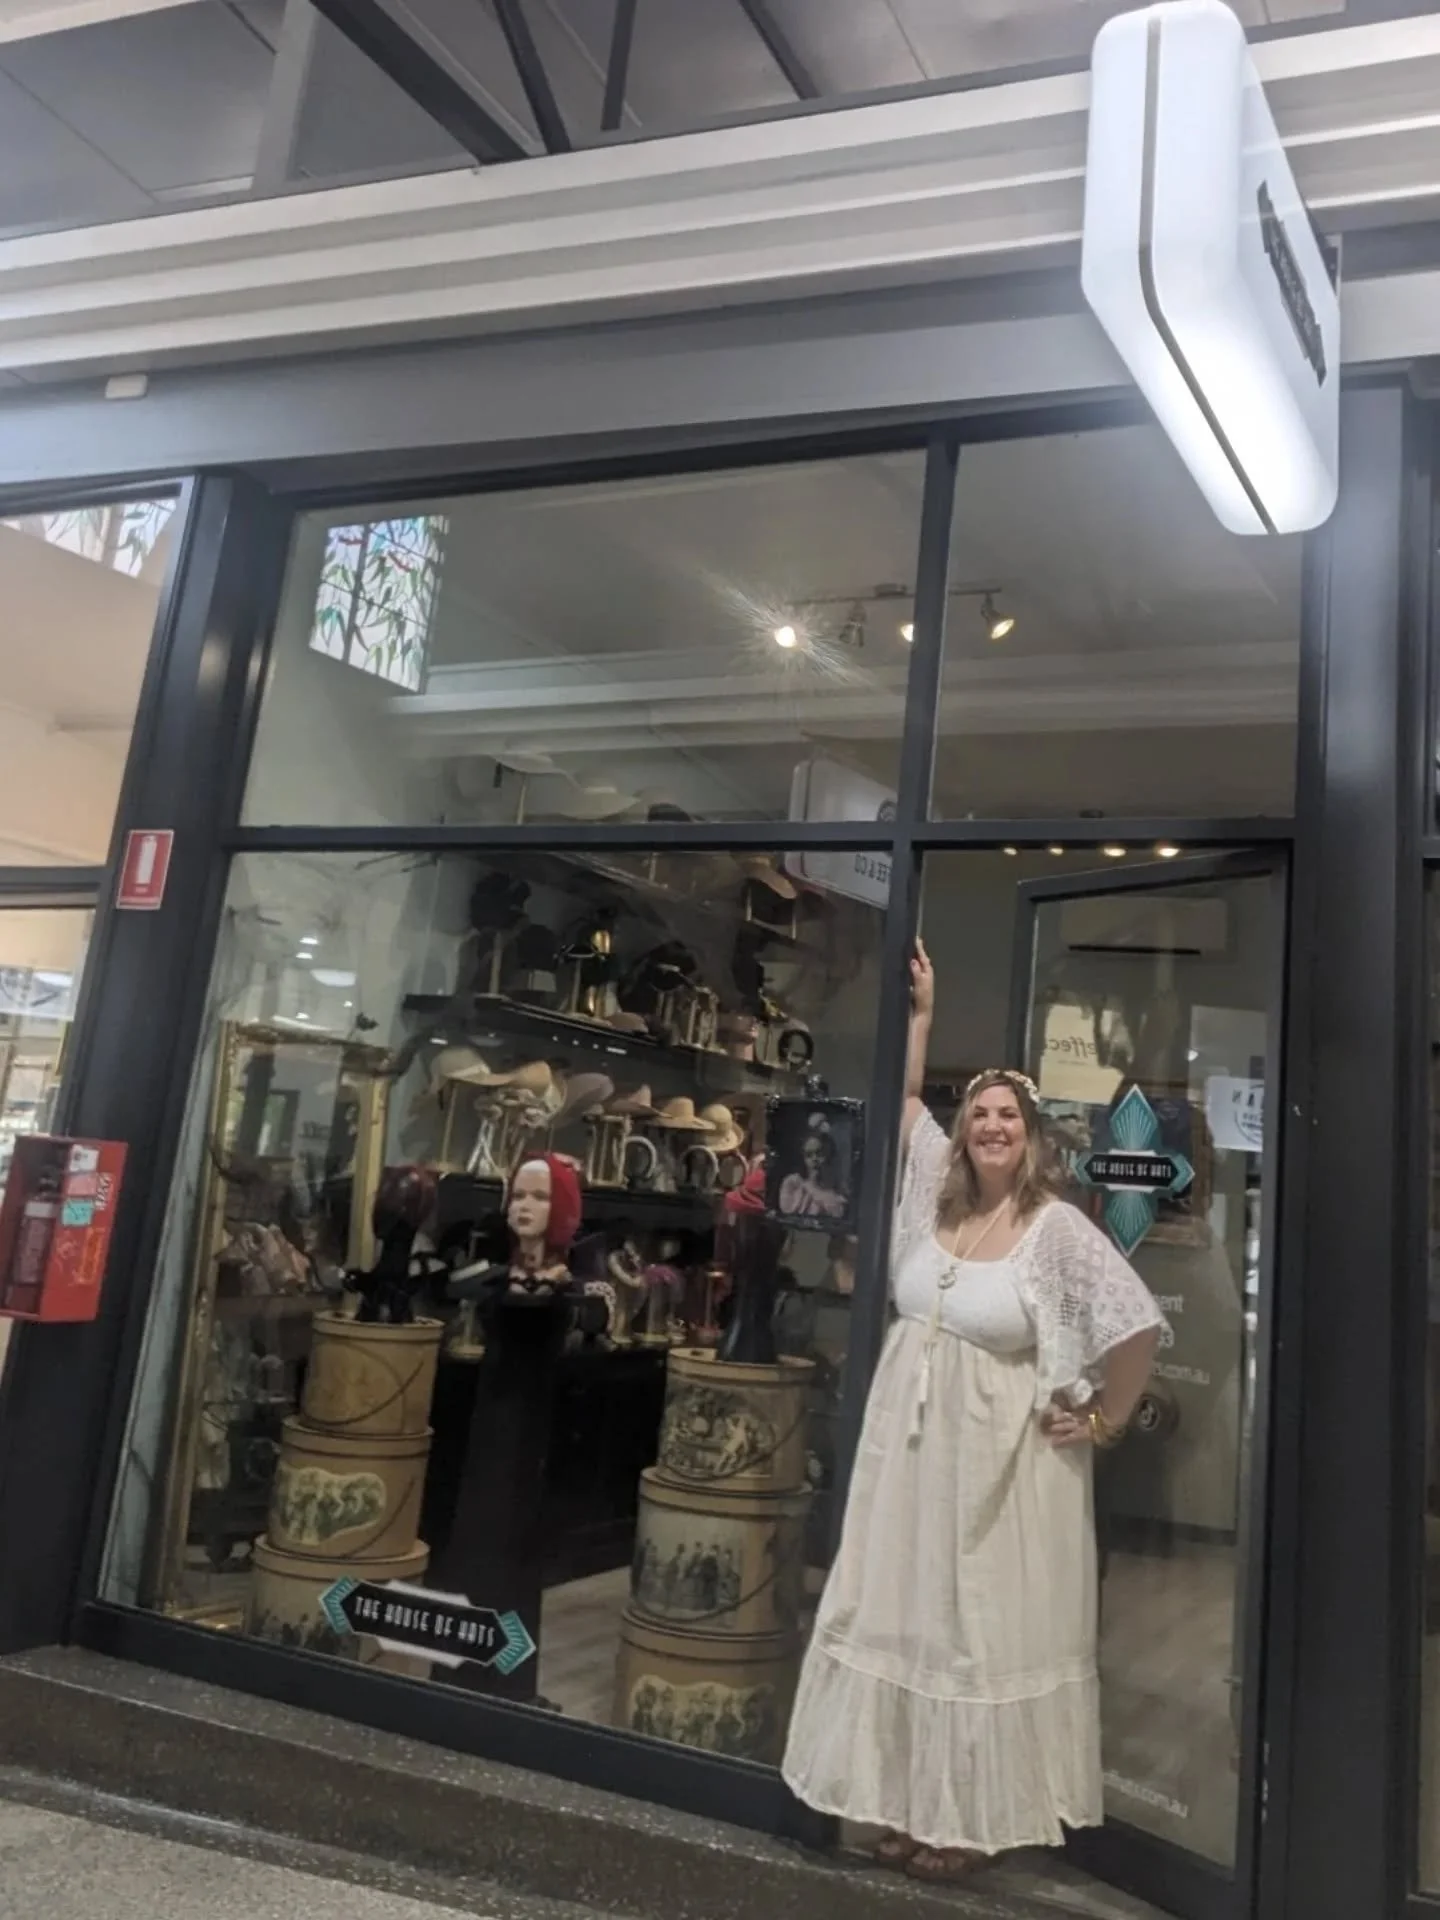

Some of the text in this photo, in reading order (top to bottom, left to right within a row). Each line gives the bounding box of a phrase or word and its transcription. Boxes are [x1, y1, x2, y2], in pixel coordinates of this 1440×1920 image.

[1092, 1161, 1172, 1178] THE HOUSE OF HATS
[354, 1596, 496, 1648] THE HOUSE OF HATS
